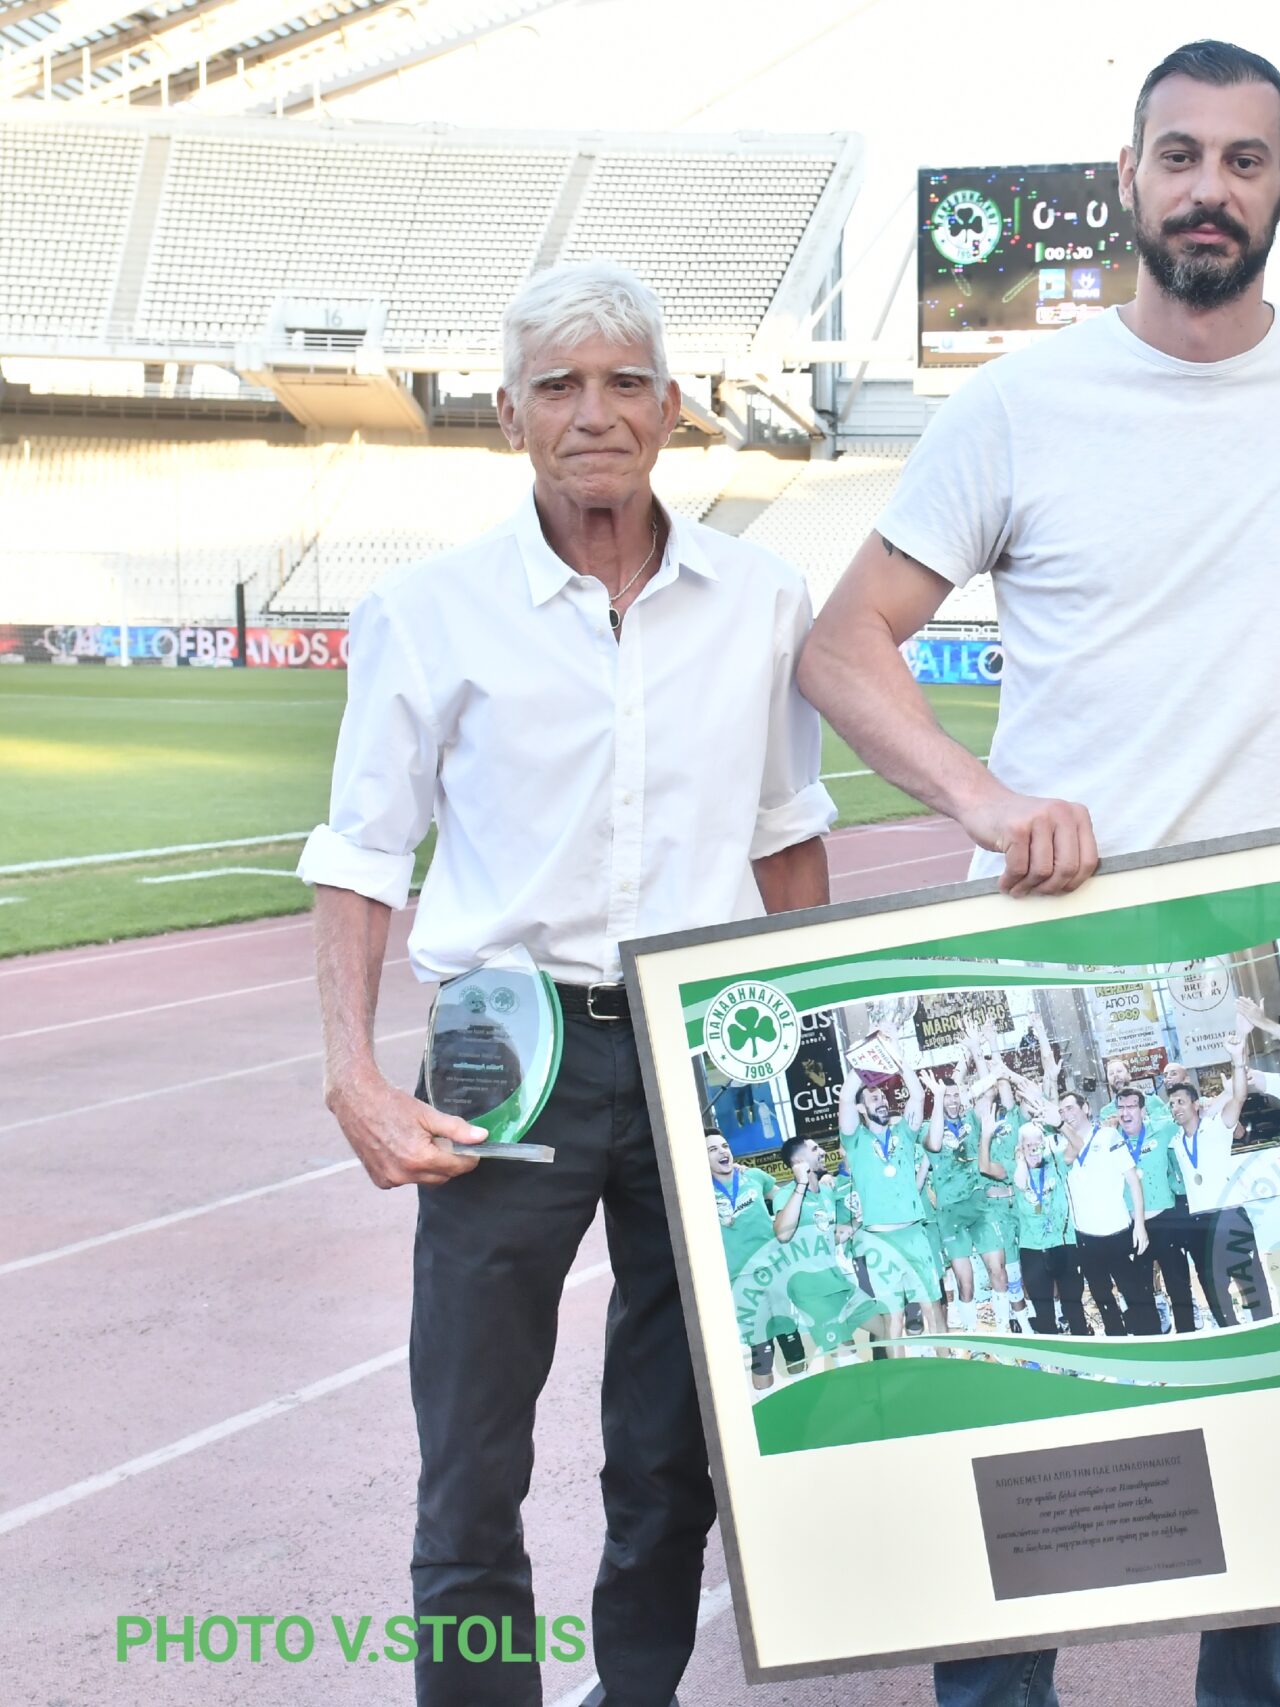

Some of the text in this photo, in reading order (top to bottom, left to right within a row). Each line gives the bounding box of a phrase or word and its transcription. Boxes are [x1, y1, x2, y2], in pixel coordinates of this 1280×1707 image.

[324, 308, 343, 328] 16
[1180, 987, 1223, 1001] FACTRY
[745, 1062, 774, 1079] 1908
[804, 1112, 840, 1124] Roaster
